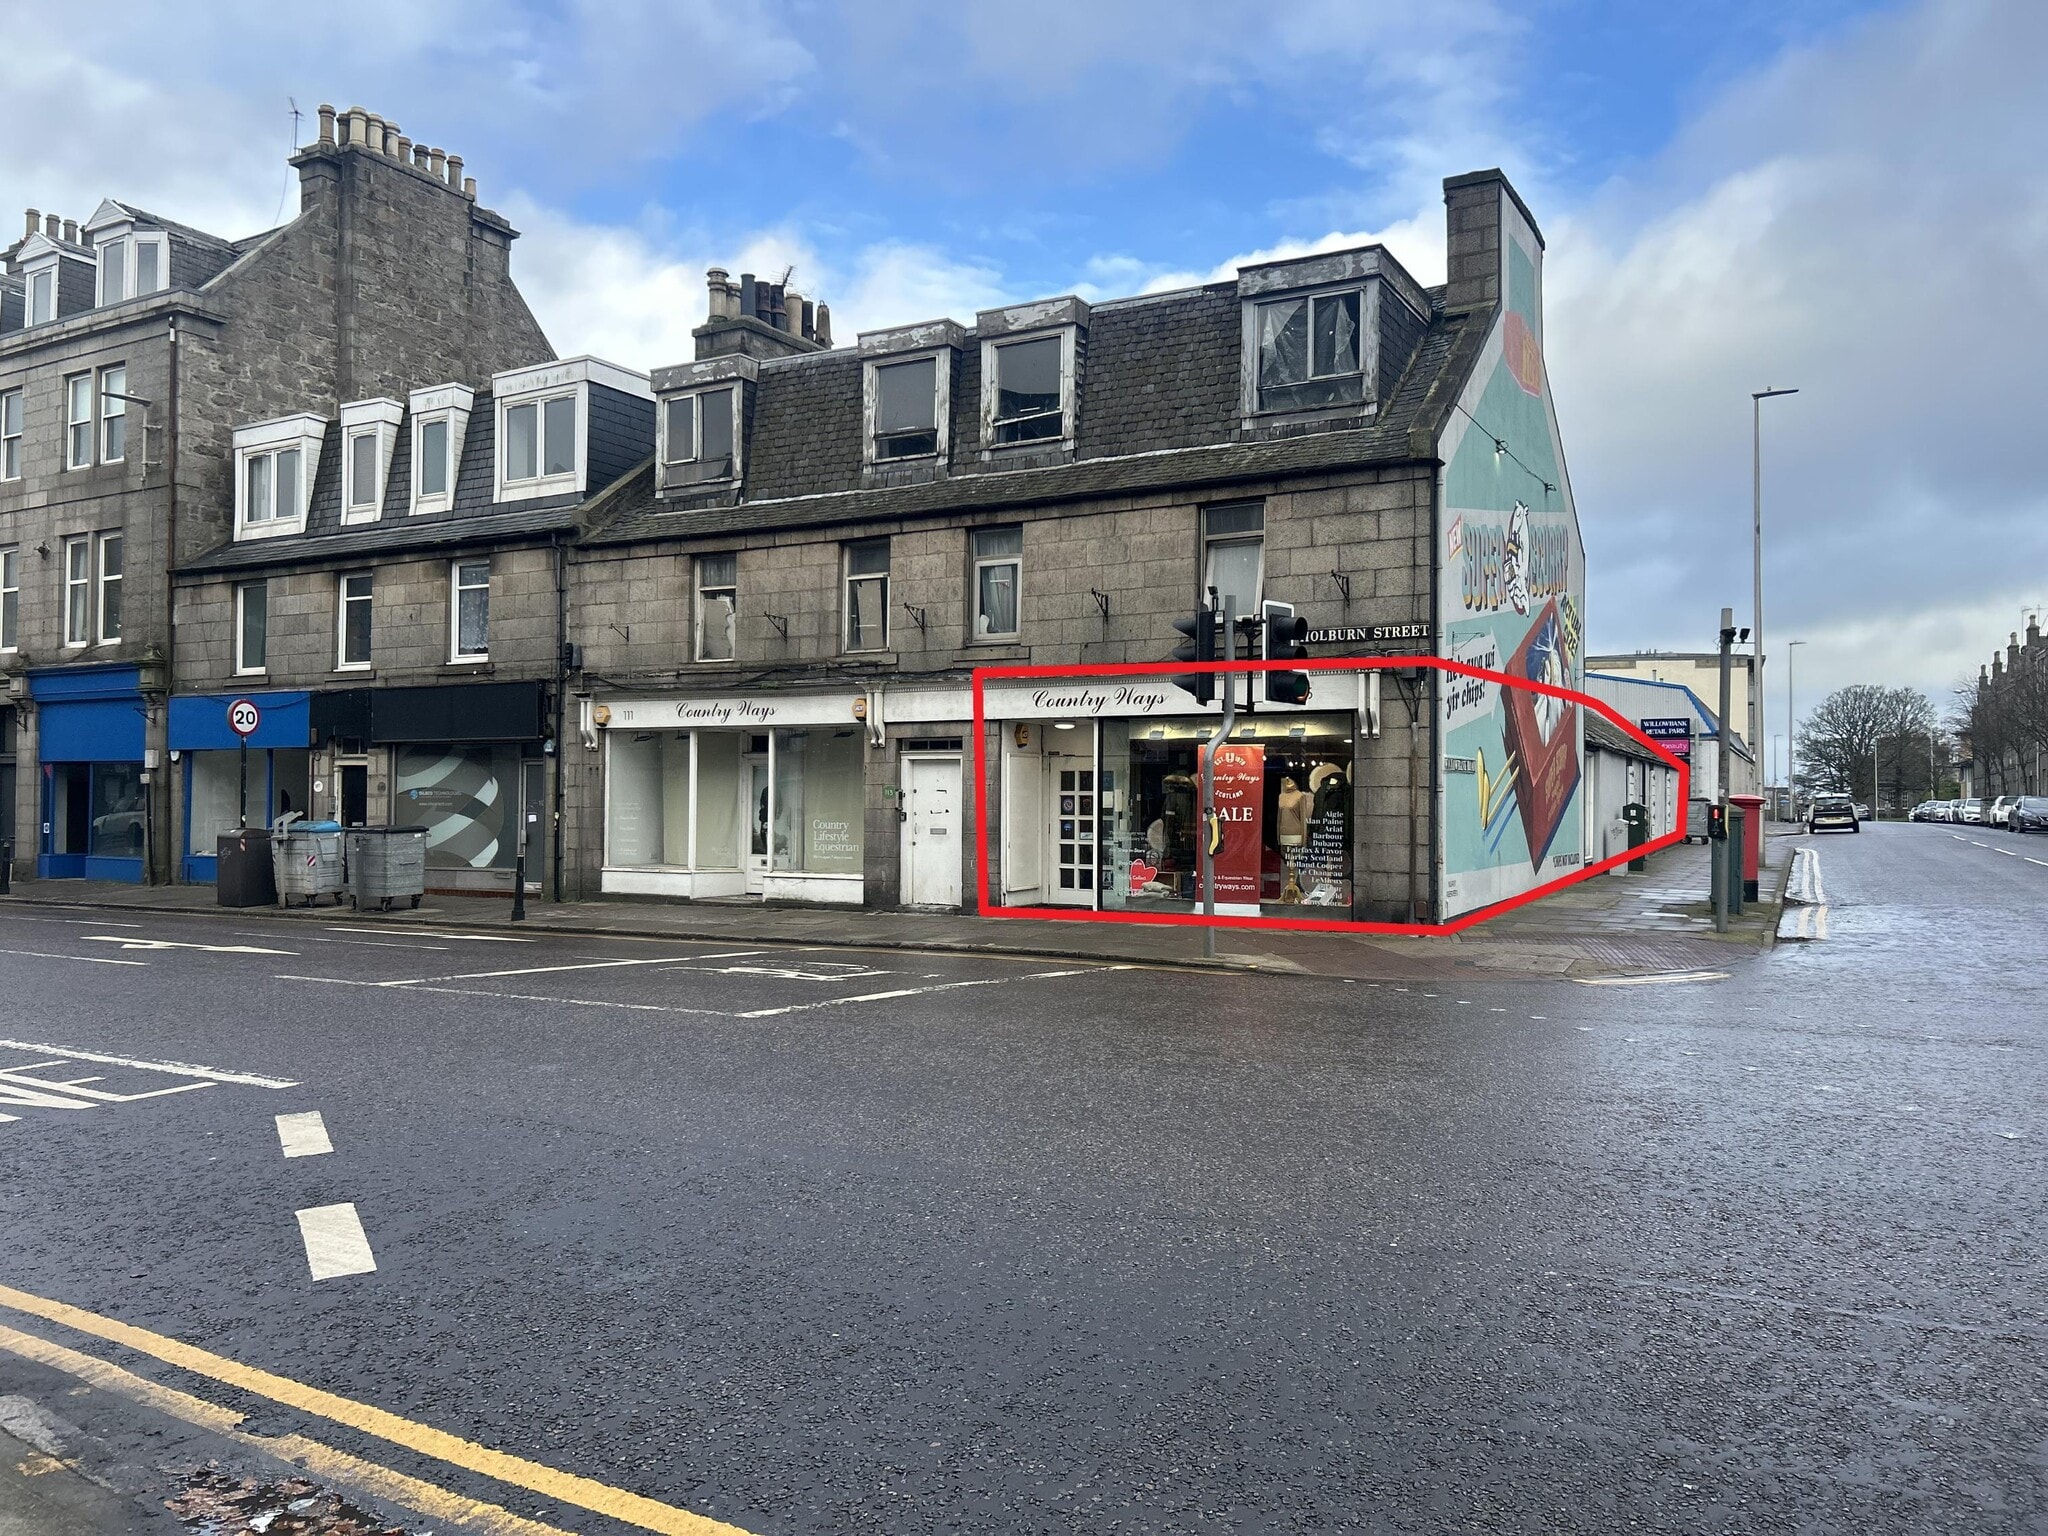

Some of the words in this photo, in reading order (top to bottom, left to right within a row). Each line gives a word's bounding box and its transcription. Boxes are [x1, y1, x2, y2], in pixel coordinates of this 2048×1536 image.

[1462, 522, 1507, 611] SUPER
[1374, 624, 1430, 639] STREET
[1032, 689, 1110, 714] Country
[1114, 686, 1169, 713] Ways
[1446, 686, 1460, 720] yir
[1461, 678, 1486, 708] chips!
[235, 710, 256, 725] 20
[623, 710, 634, 720] 111
[675, 702, 734, 724] Country
[736, 700, 778, 723] Ways
[1201, 773, 1234, 784] ntry
[1237, 772, 1260, 784] Ways
[1215, 789, 1243, 799] SCOTLAND
[1203, 807, 1253, 822] ALE
[1325, 810, 1344, 818] Aigle
[813, 819, 849, 832] Country
[813, 830, 850, 843] Lifestyle
[1312, 832, 1344, 840] Barbour
[813, 841, 859, 853] Equestrian
[1312, 840, 1343, 848] Dubarry
[1284, 853, 1308, 861] Harley
[1286, 860, 1315, 868] Holland
[1316, 861, 1343, 869] Cooper
[1198, 883, 1256, 891] ctryways.com
